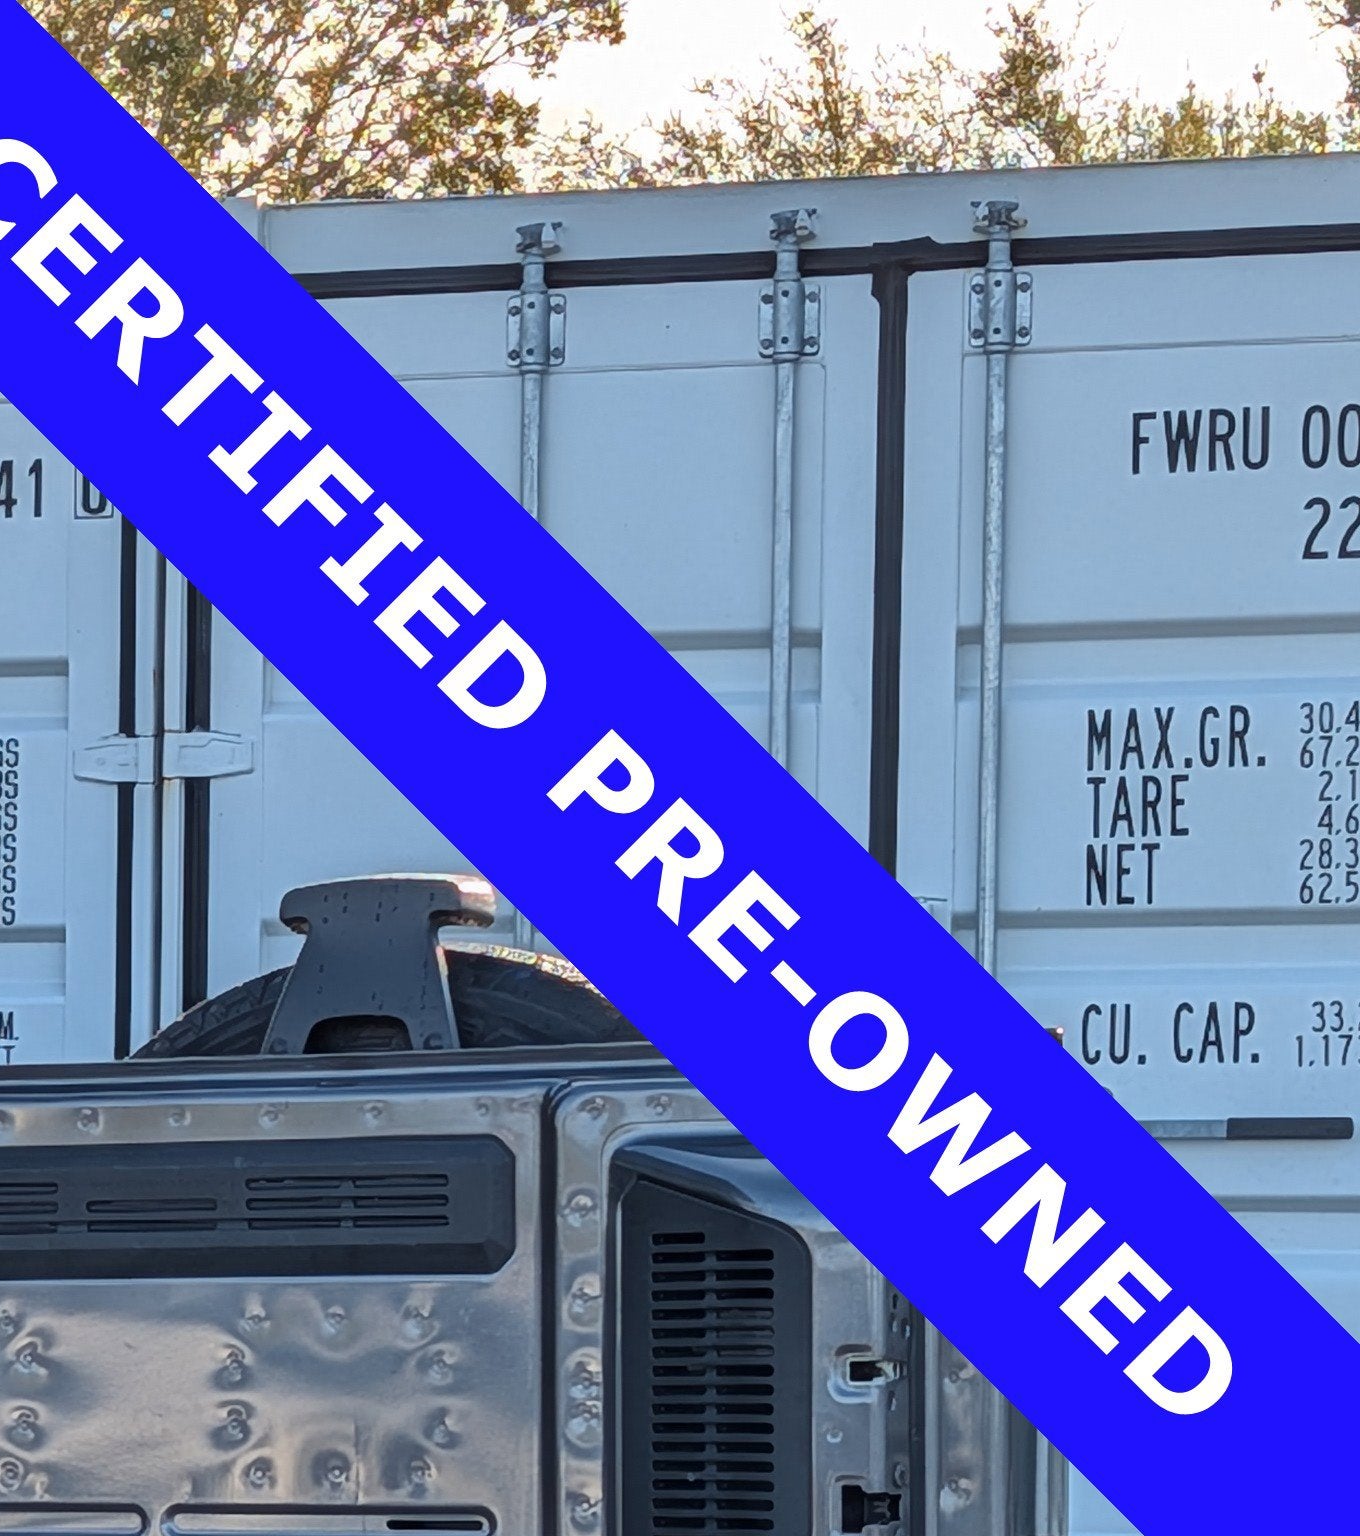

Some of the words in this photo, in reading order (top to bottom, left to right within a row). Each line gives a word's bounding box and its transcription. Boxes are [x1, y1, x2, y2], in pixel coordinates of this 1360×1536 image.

[1132, 406, 1270, 475] FWRU
[1302, 496, 1360, 560] 22
[1087, 705, 1266, 771] MAX.GR.
[1086, 774, 1190, 839] TARE
[1086, 843, 1161, 906] NET
[1081, 1003, 1147, 1065] CU.
[1173, 1001, 1260, 1064] CAP.
